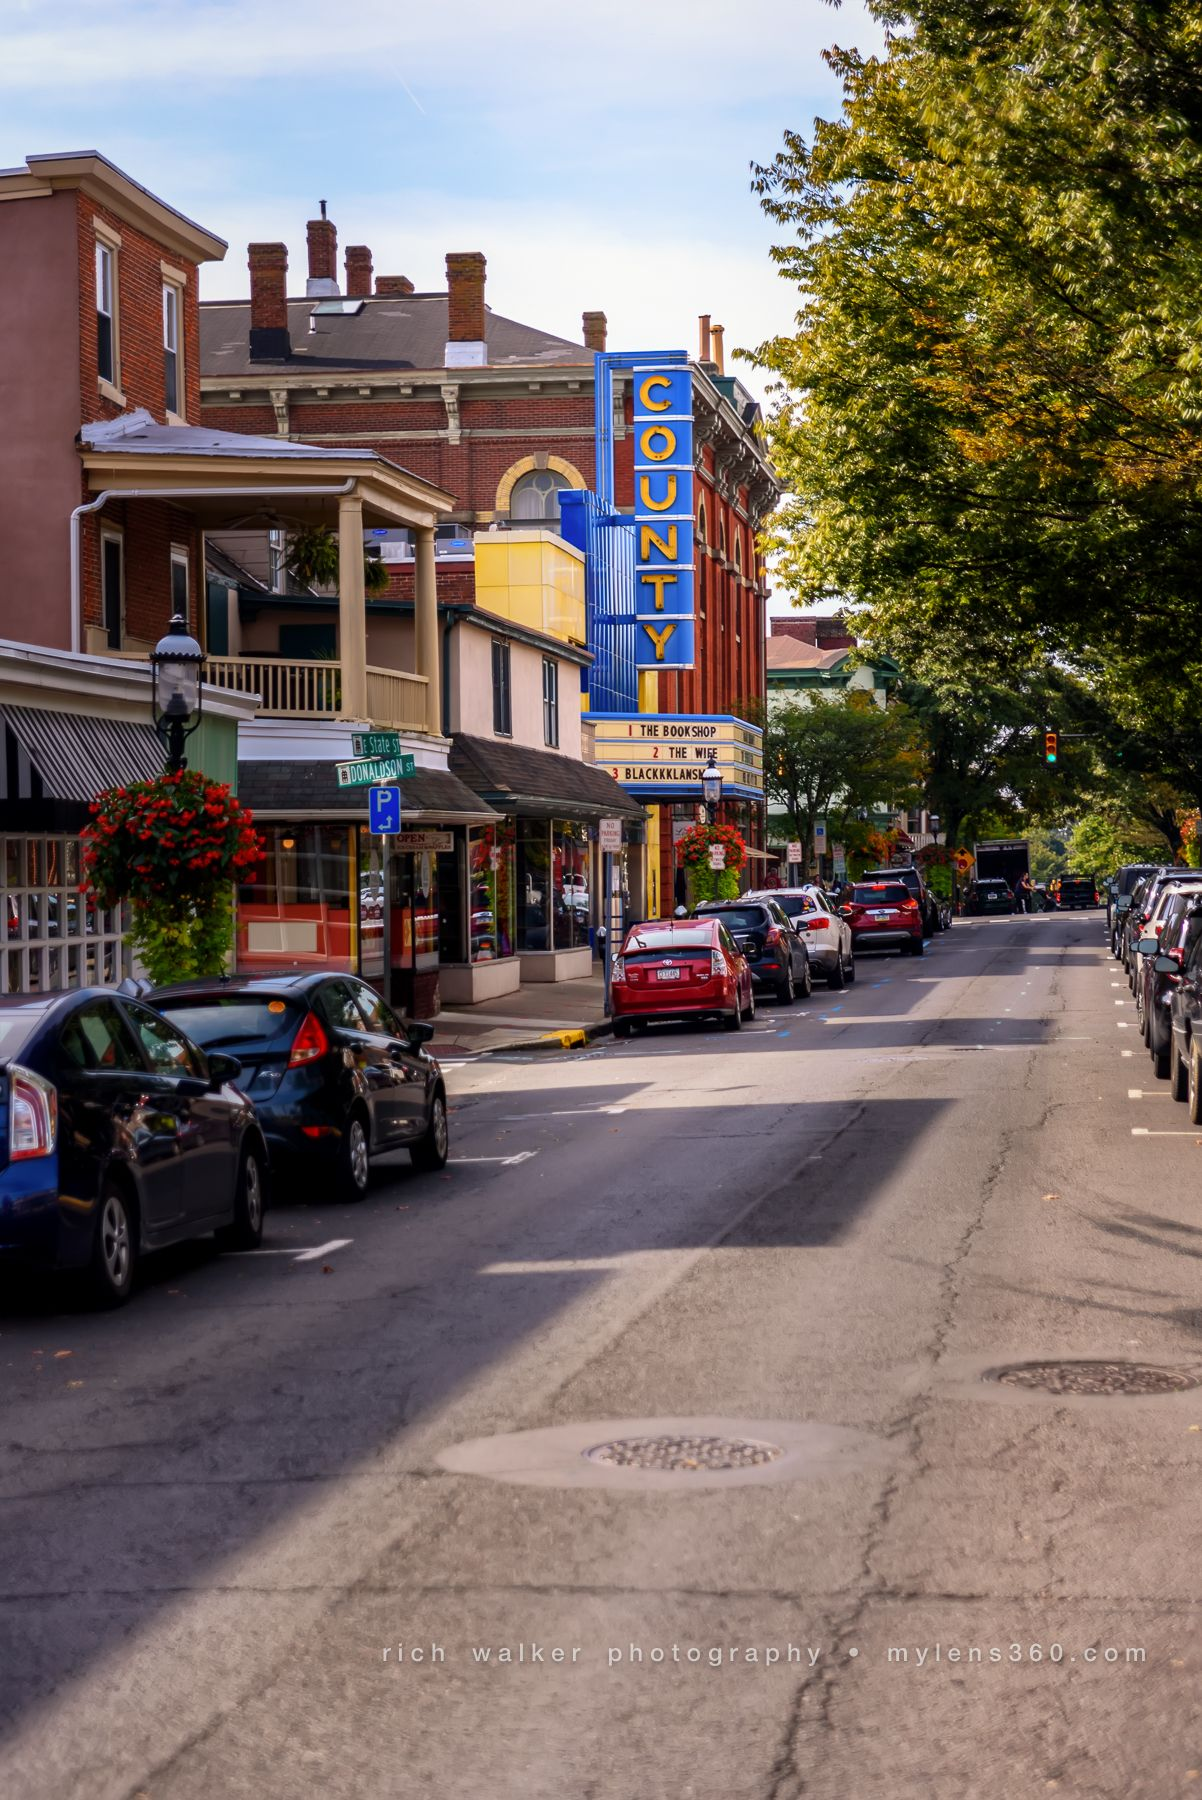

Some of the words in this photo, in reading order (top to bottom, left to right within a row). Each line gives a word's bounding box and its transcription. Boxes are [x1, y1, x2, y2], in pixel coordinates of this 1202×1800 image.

[639, 374, 678, 661] COUNTY
[640, 724, 659, 737] THE
[369, 736, 390, 754] State
[653, 746, 659, 758] 2
[669, 747, 687, 758] THE
[695, 747, 718, 759] WIFE
[350, 759, 404, 782] DONALDSON
[405, 762, 414, 772] ST
[612, 768, 619, 779] 3
[376, 790, 392, 813] P
[396, 833, 426, 843] OPEN
